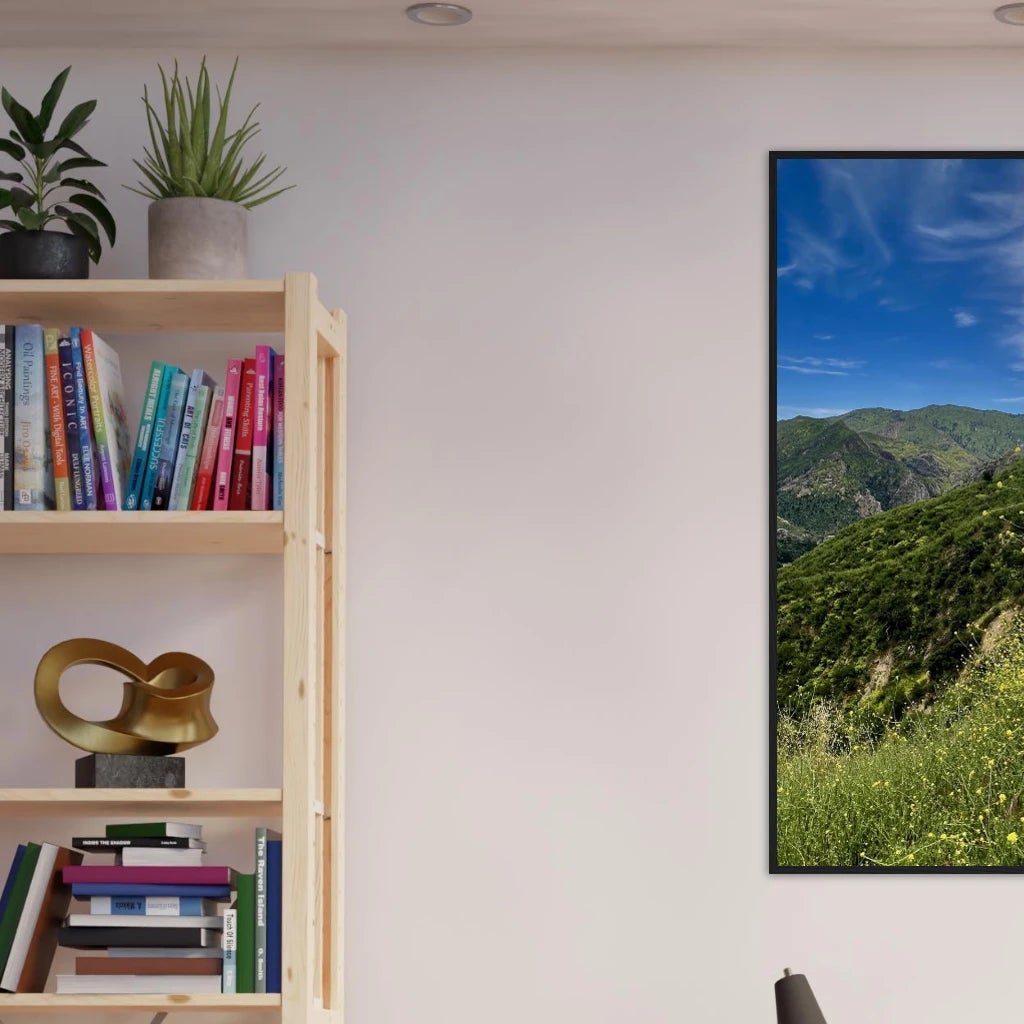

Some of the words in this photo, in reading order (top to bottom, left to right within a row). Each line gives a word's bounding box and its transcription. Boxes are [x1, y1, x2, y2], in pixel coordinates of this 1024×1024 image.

[23, 342, 33, 357] Oil
[49, 365, 59, 383] FINE
[75, 361, 83, 377] Find
[84, 343, 99, 393] Watercolor
[20, 360, 33, 406] Paintings
[51, 384, 60, 399] ART
[75, 378, 85, 404] Beauty
[62, 363, 78, 430] ICONIC
[242, 382, 254, 417] Parenting
[53, 405, 62, 422] With
[91, 394, 104, 433] Portraits
[51, 423, 65, 447] Digital
[241, 418, 250, 438] Skills
[56, 449, 65, 466] Tools
[257, 894, 265, 927] Island
[226, 914, 234, 930] Touch
